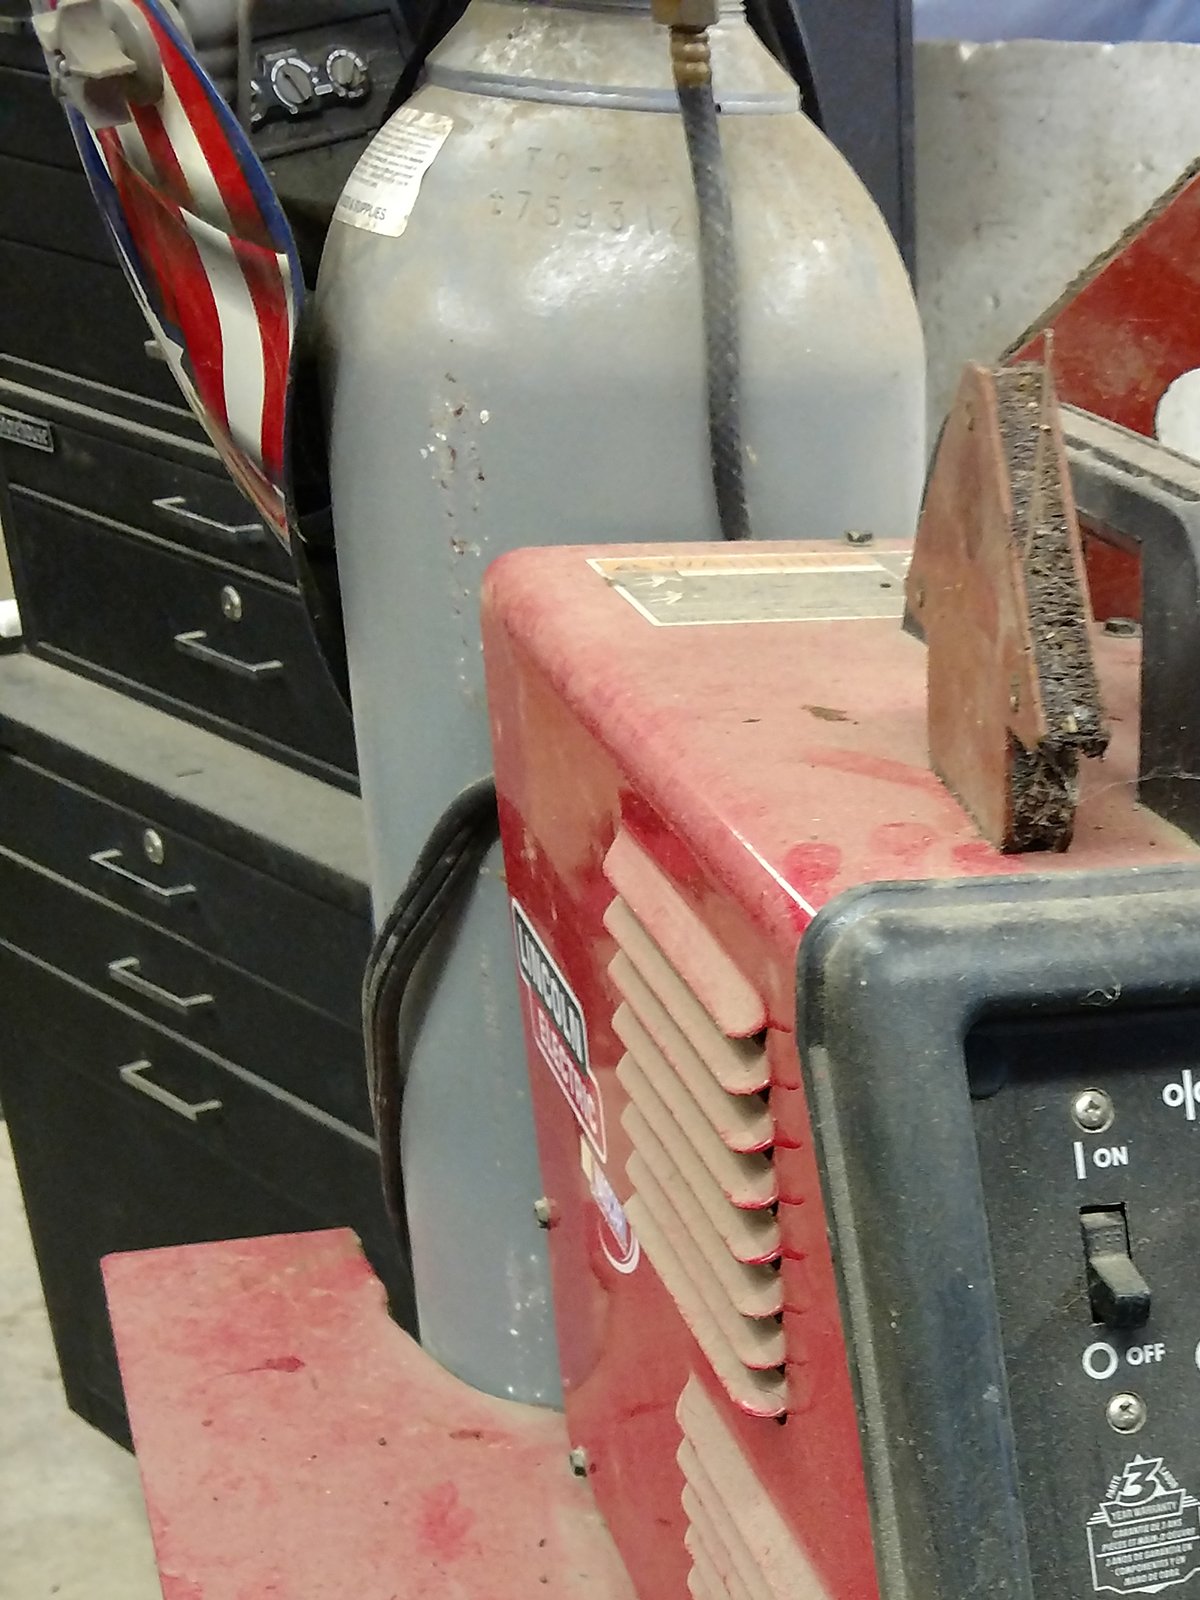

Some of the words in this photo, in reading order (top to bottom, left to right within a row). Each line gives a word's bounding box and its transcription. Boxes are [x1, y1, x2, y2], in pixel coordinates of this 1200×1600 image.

[518, 922, 584, 1064] LINCOLN
[1093, 1147, 1128, 1168] ON
[1126, 1343, 1166, 1366] OFF
